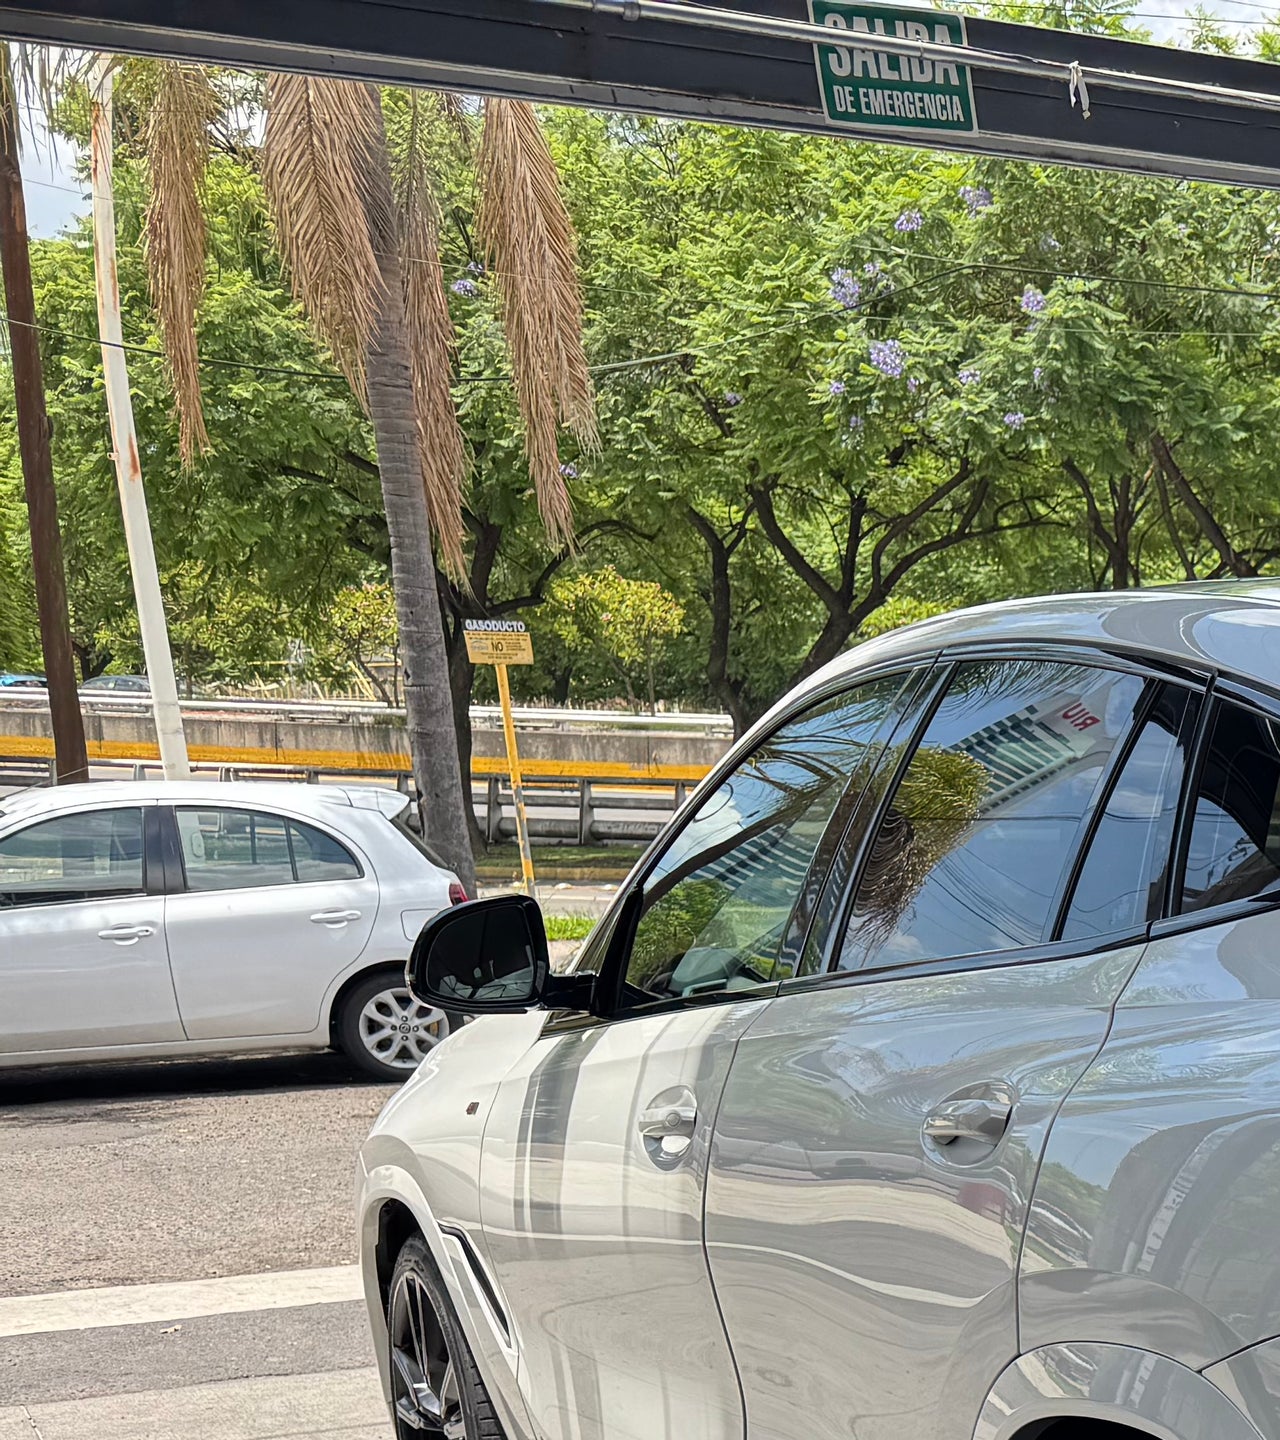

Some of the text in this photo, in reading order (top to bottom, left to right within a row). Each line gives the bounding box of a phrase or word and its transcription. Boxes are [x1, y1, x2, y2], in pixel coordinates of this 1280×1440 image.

[824, 12, 960, 86] SALIDA
[832, 85, 965, 122] DE EMERGENCIA
[465, 619, 526, 632] GASODUCTO
[491, 641, 504, 652] NO
